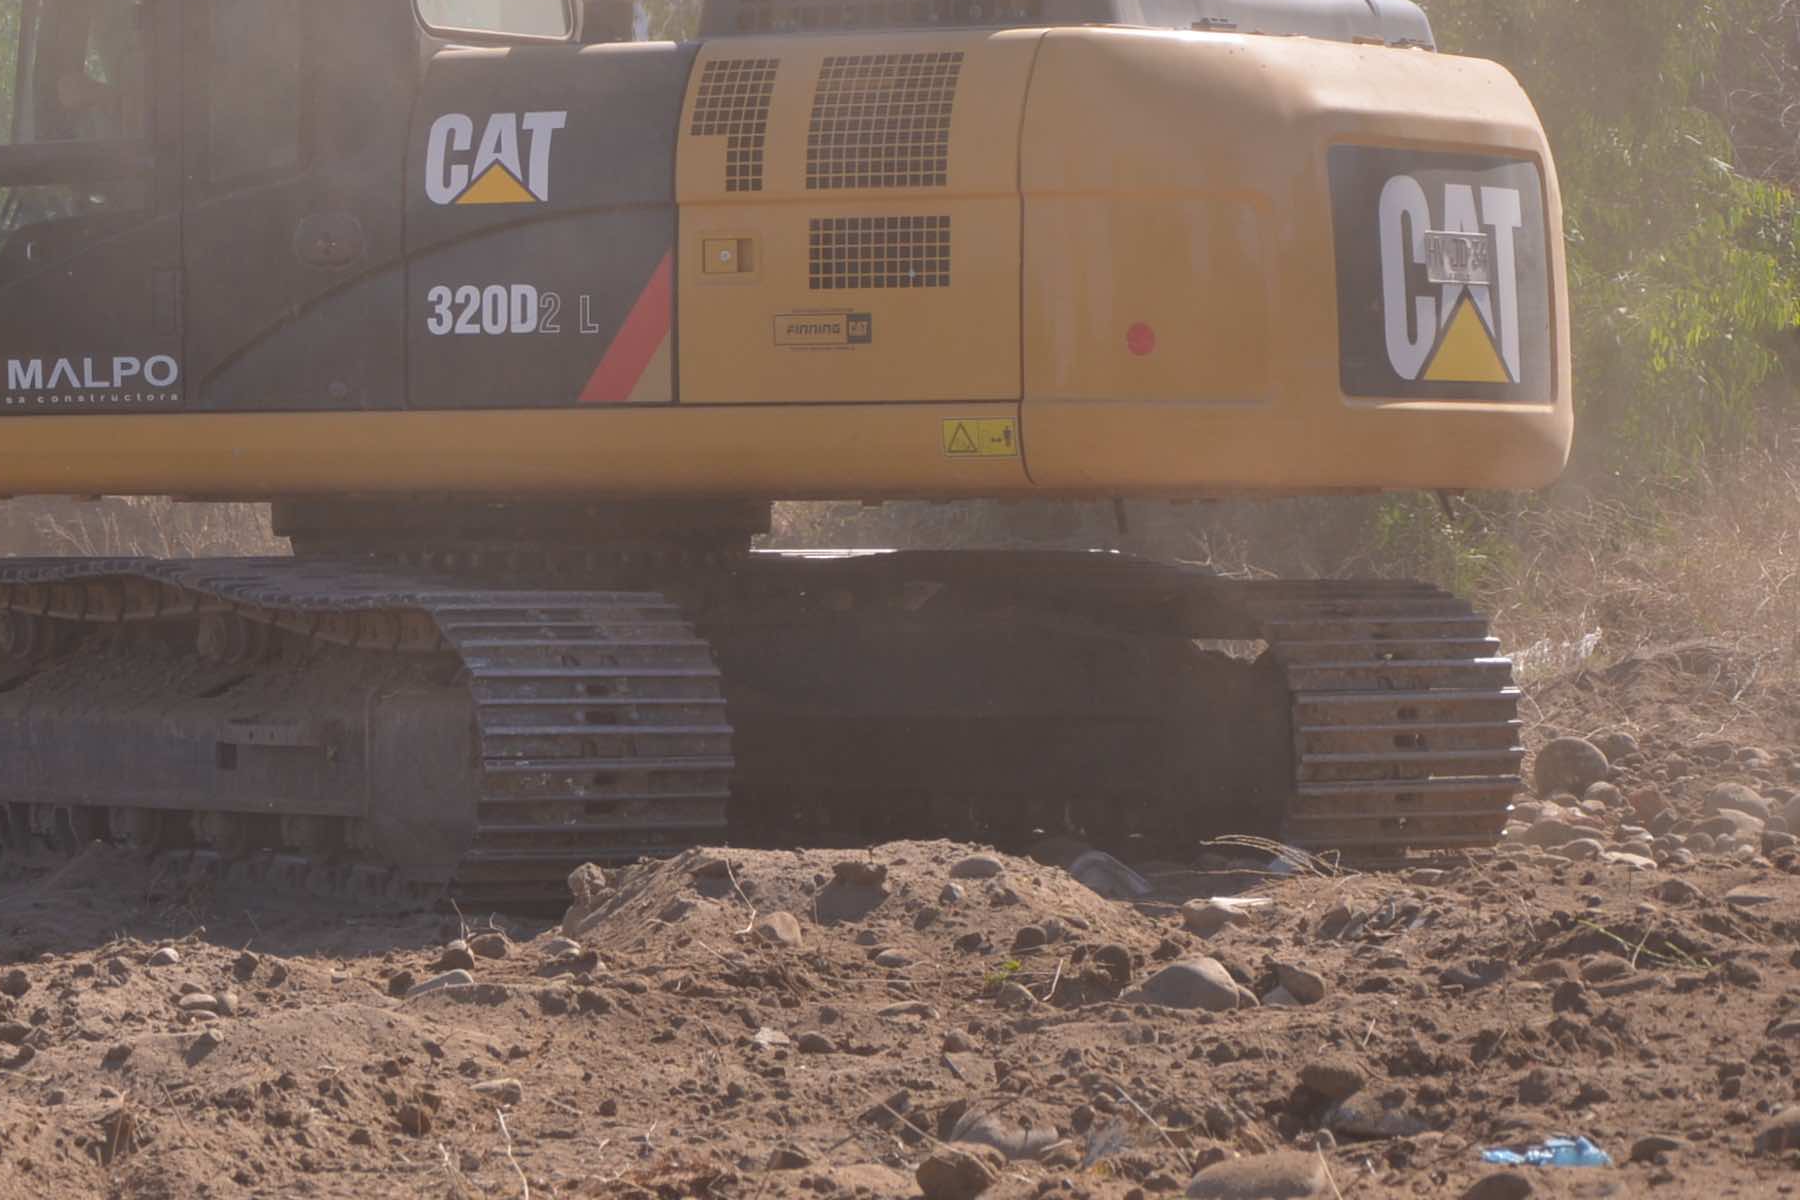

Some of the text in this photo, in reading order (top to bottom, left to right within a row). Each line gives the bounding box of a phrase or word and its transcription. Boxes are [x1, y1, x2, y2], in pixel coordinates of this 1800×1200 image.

[425, 111, 568, 205] CAT
[1379, 174, 1522, 384] CAT
[579, 294, 600, 334] L
[7, 355, 179, 390] MALPO
[37, 392, 179, 404] constructora
